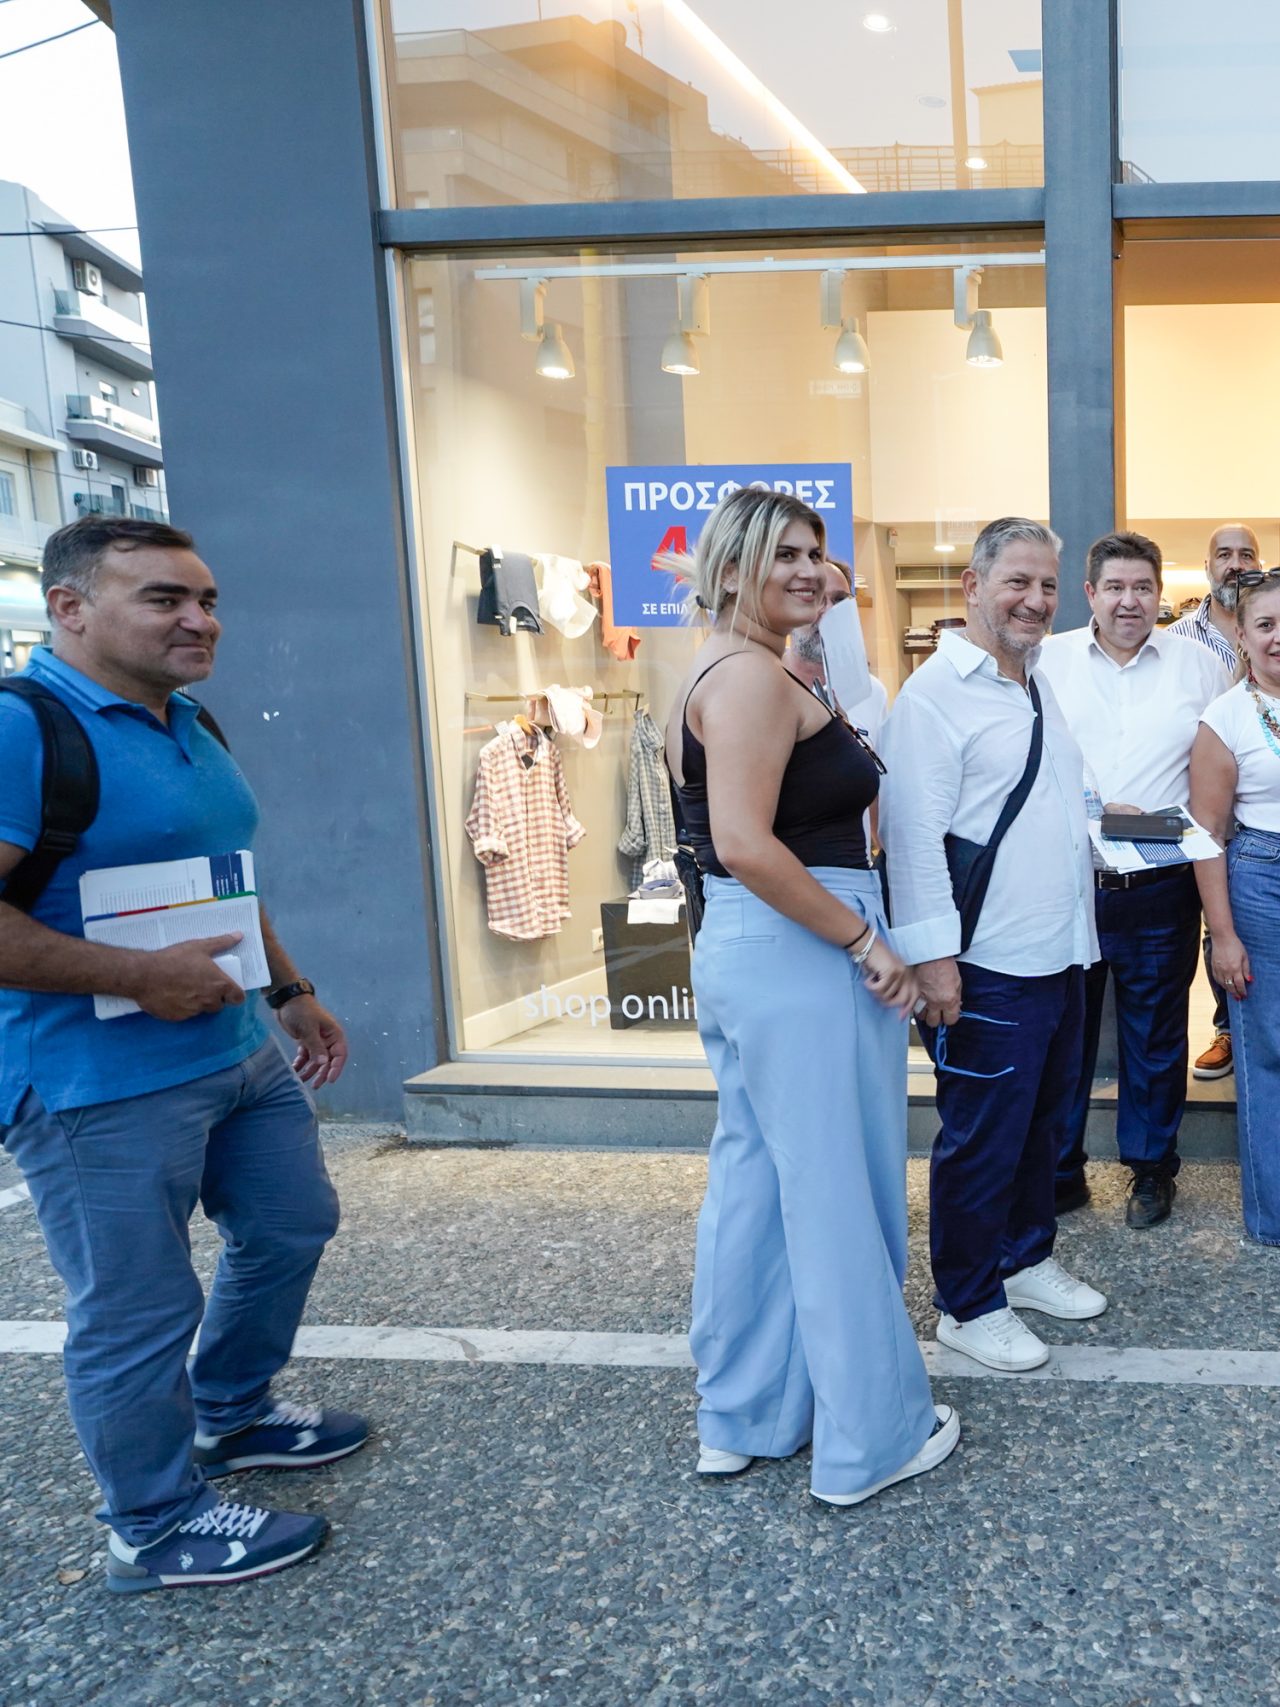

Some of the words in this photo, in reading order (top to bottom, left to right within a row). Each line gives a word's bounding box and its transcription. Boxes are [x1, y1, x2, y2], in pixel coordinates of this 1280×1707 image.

[642, 603, 658, 615] ΣΕ
[524, 983, 612, 1027] shop
[621, 985, 698, 1020] onli
